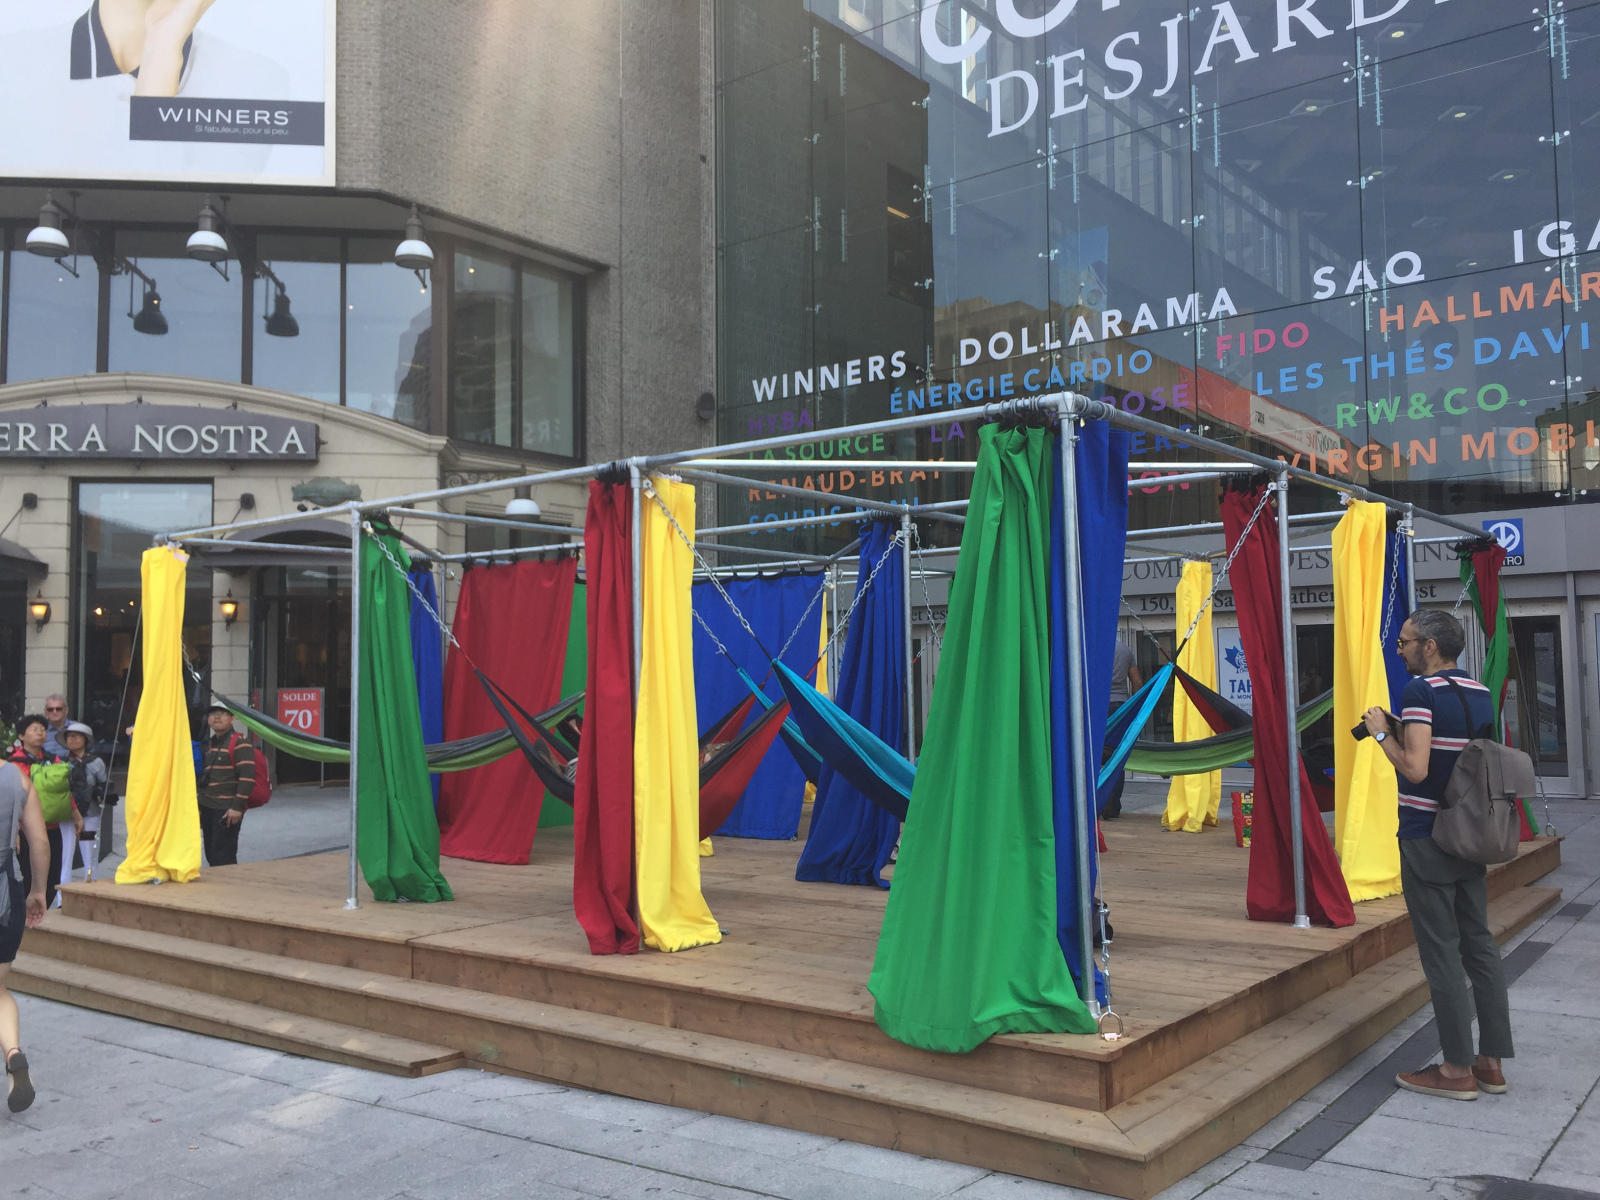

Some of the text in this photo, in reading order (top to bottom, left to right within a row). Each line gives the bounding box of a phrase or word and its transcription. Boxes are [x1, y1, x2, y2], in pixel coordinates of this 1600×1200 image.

[158, 107, 289, 126] WINNERS
[242, 126, 263, 135] pour
[1313, 250, 1425, 300] SAQ
[960, 286, 1237, 366] DOLLARAMA
[1216, 322, 1310, 360] FIDO
[752, 350, 907, 403] WINNERS
[1256, 322, 1590, 396] LES THÉS DAVI
[890, 349, 1153, 414] ÉNERGIE CARDIO
[750, 409, 812, 436] HYBA
[1336, 383, 1528, 430] RW&CO.
[131, 424, 307, 454] NOSTRA
[1461, 419, 1595, 461] MOBI
[1140, 597, 1174, 613] 150,
[282, 692, 317, 702] SOLDE
